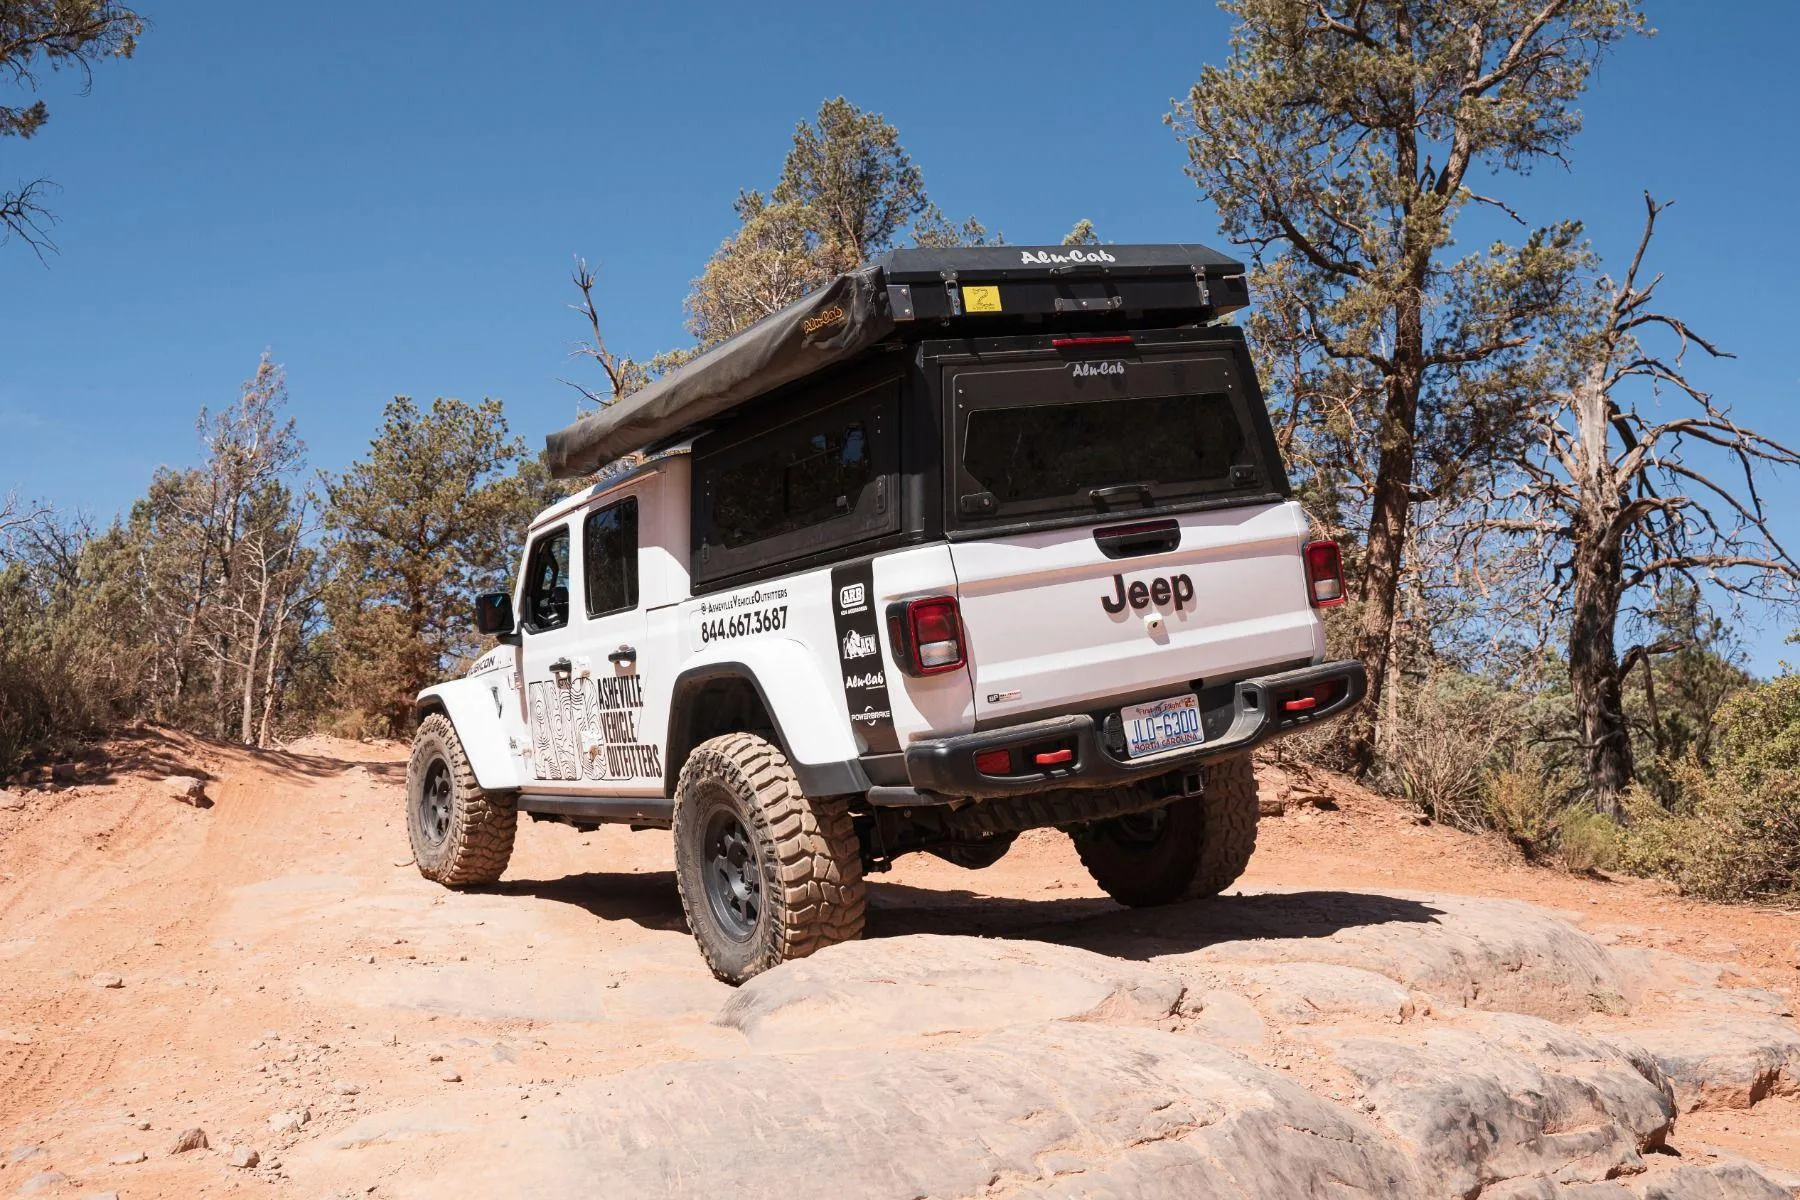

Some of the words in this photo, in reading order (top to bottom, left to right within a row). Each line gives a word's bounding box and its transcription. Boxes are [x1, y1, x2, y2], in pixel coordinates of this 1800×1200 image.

[1020, 249, 1116, 265] Alu-Cab
[803, 305, 843, 334] Alu-Cab
[1072, 361, 1125, 378] Alu-Cab
[843, 587, 862, 604] ARB
[1100, 573, 1194, 614] Jeep
[701, 605, 788, 644] 844.667.3687
[597, 674, 644, 710] ASHEVILLE
[846, 671, 884, 689] Alu-Cab
[600, 711, 637, 743] VEHICLE
[851, 710, 891, 722] POWERBRAKE
[1134, 741, 1160, 752] NORTH
[1162, 733, 1198, 747] CAROLINA
[606, 743, 663, 778] OUTFITTERS
